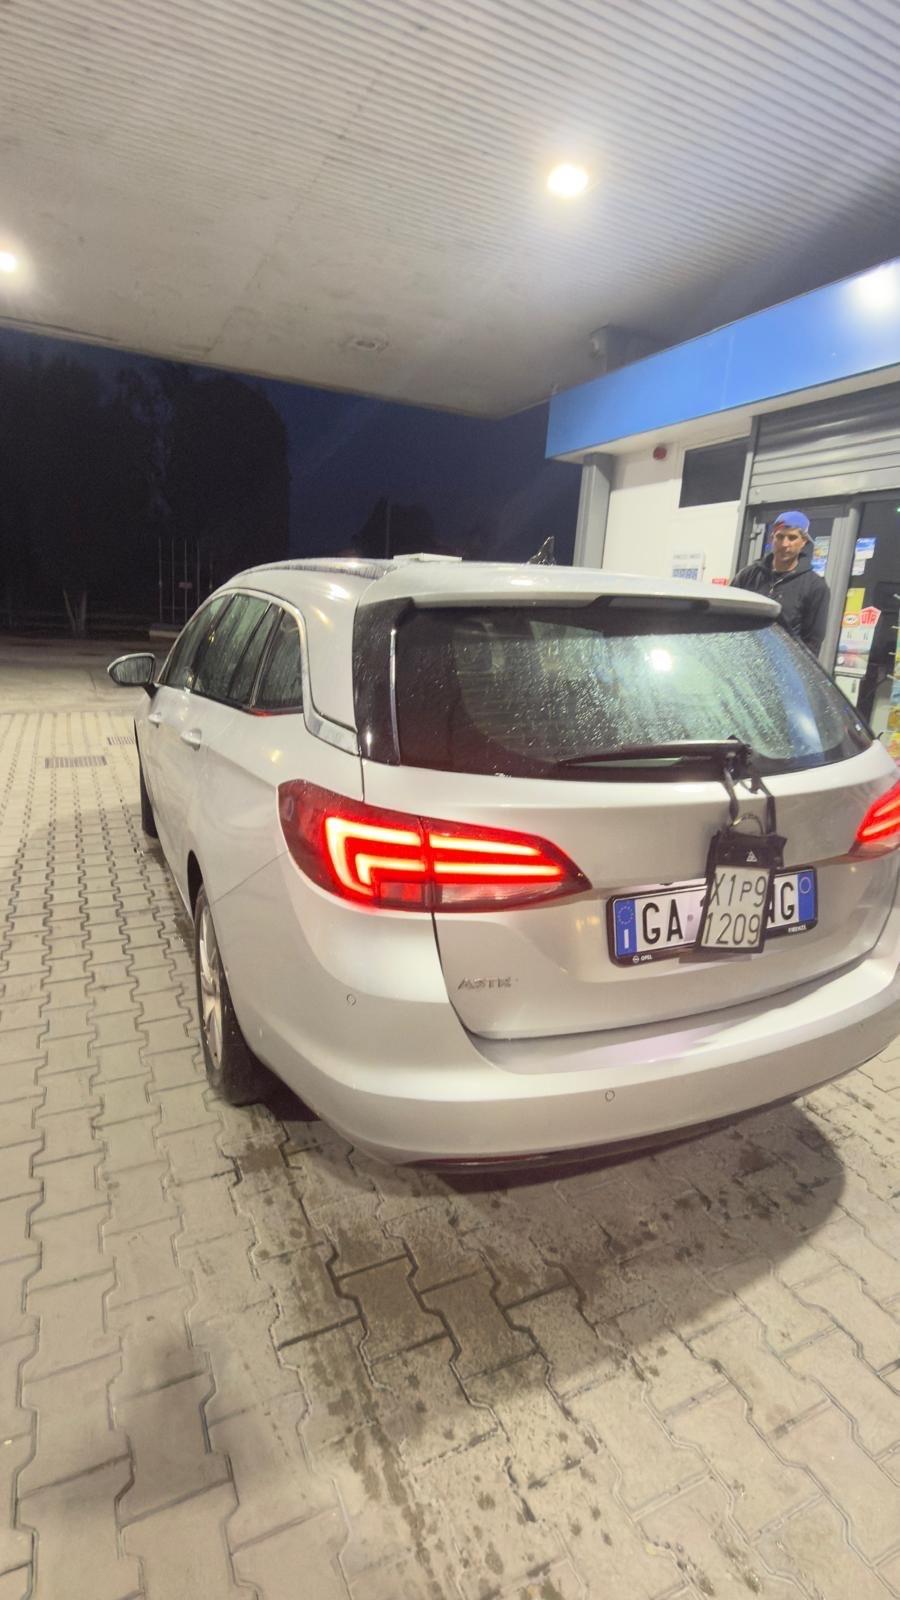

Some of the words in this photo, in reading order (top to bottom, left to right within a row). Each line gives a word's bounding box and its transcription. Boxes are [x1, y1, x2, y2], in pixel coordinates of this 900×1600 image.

[642, 899, 684, 945] GA
[703, 912, 761, 945] 1209
[457, 977, 520, 990] ASTR
